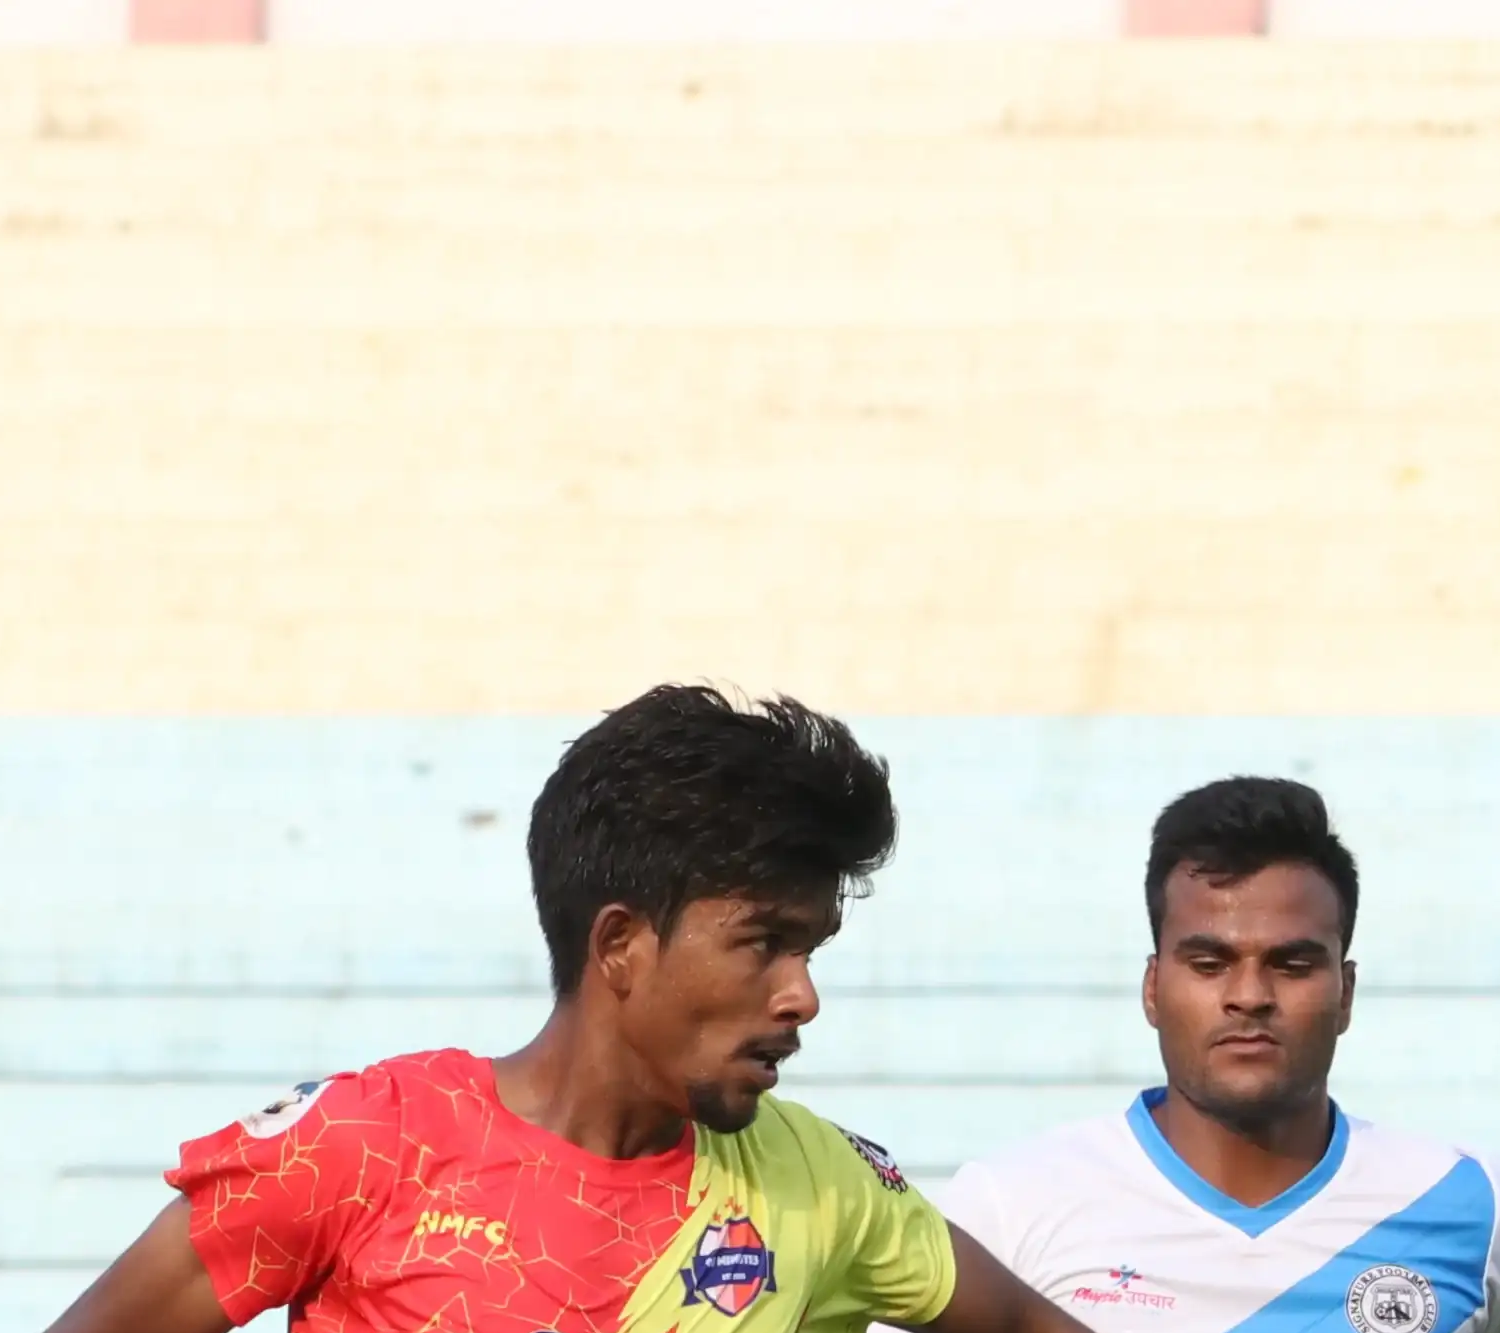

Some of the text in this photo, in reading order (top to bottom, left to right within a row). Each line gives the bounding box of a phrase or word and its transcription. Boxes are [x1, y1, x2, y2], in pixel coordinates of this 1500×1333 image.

[415, 1210, 508, 1245] NMFC
[1376, 1267, 1433, 1297] FOOTBALL
[1420, 1303, 1435, 1333] CLUB
